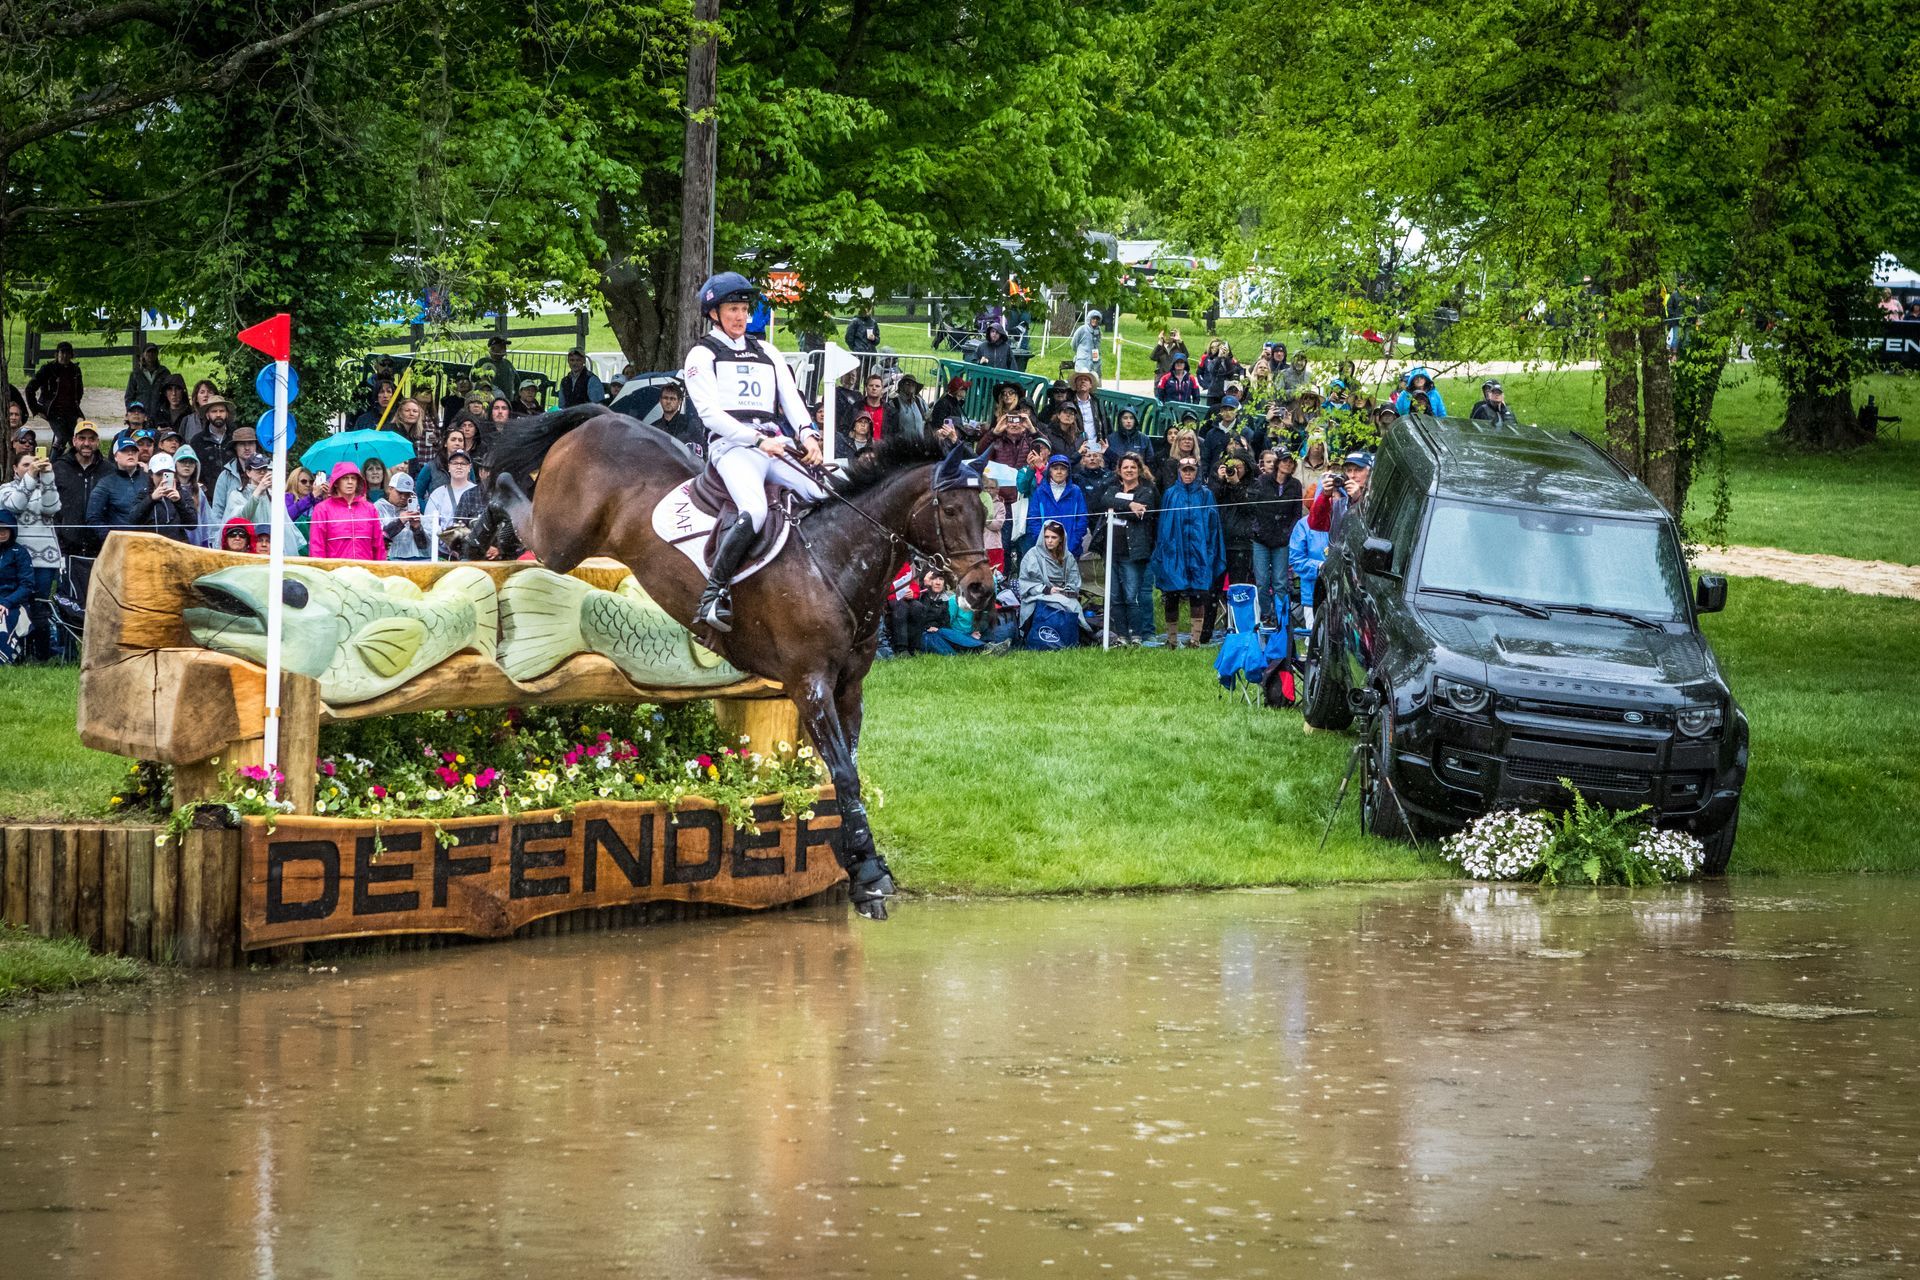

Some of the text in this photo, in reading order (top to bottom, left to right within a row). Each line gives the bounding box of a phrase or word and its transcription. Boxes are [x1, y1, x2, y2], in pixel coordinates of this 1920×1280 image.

[738, 380, 762, 397] 20
[674, 502, 693, 532] NAF
[1520, 678, 1656, 699] DEFENDER
[266, 797, 844, 925] DEFENDER
